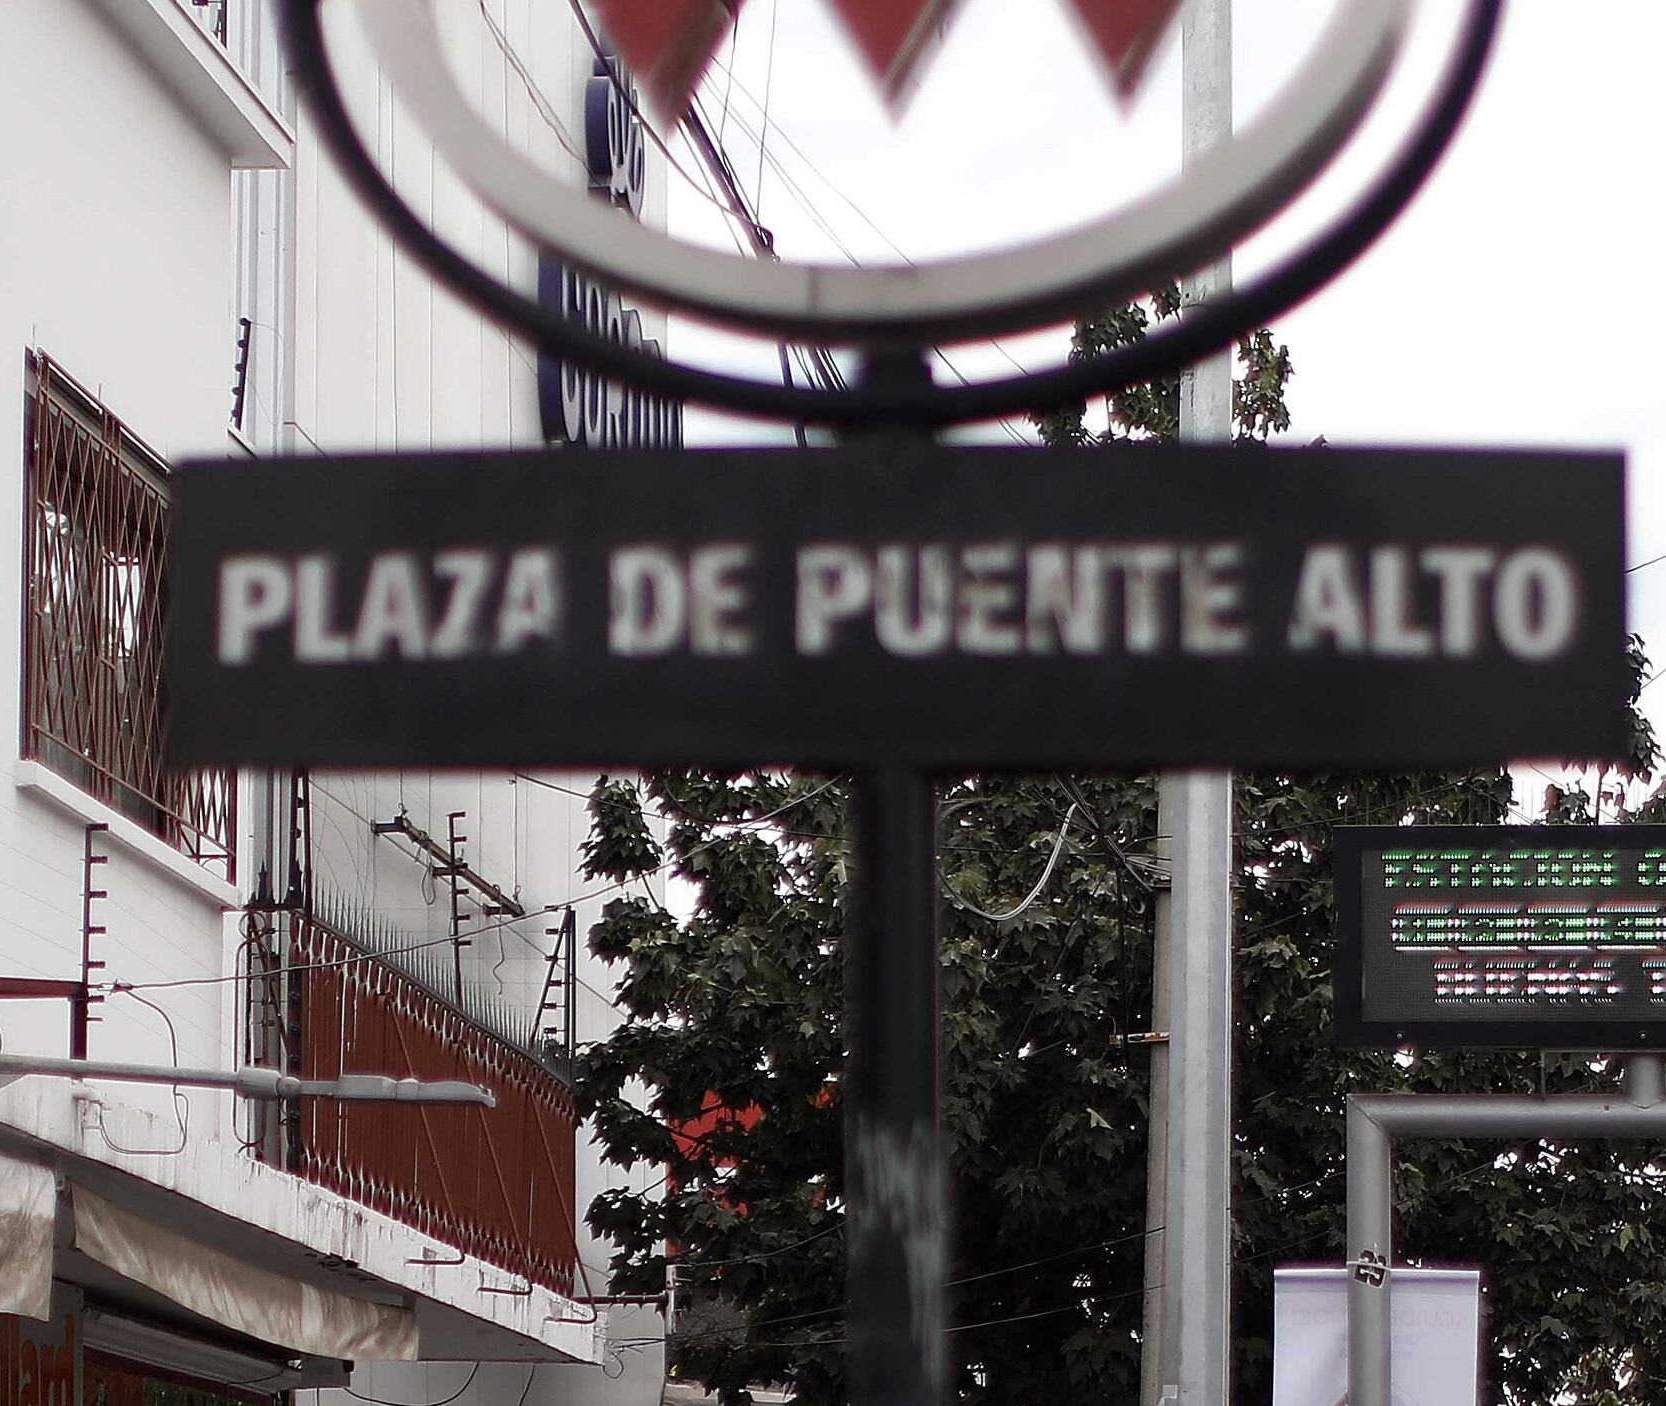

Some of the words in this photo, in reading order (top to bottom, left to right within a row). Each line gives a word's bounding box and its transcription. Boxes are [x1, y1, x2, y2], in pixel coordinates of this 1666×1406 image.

[217, 550, 554, 663] PLAZA
[610, 547, 753, 657] DE
[798, 545, 1246, 656] PUENTE
[1289, 545, 1579, 657] ALTO
